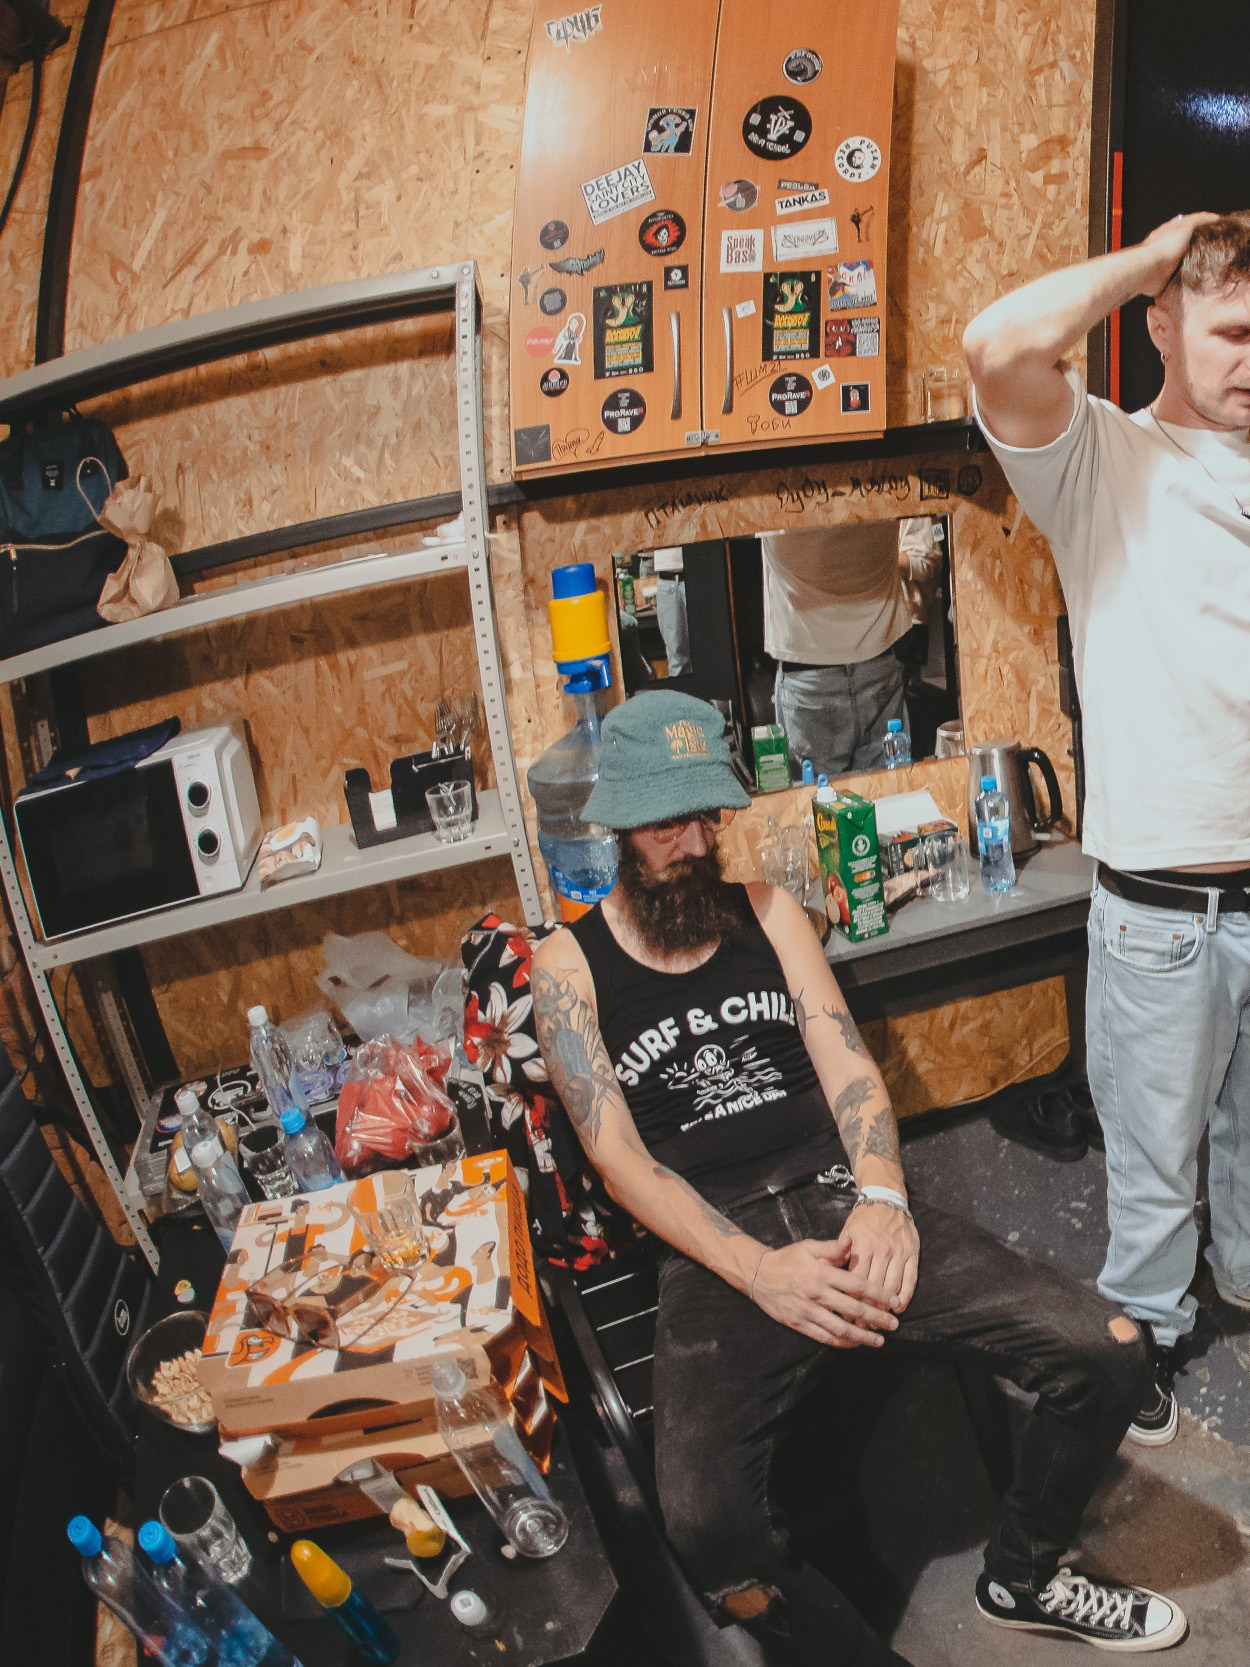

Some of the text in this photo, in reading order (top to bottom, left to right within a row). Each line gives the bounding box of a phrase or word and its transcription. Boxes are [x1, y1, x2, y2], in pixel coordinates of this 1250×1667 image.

[583, 161, 643, 196] DEEJAY
[588, 173, 647, 204] SAINT CITY
[589, 181, 650, 213] LOVERS
[777, 191, 827, 210] TANKAS
[614, 1017, 681, 1087] SURF
[686, 1007, 719, 1036] &
